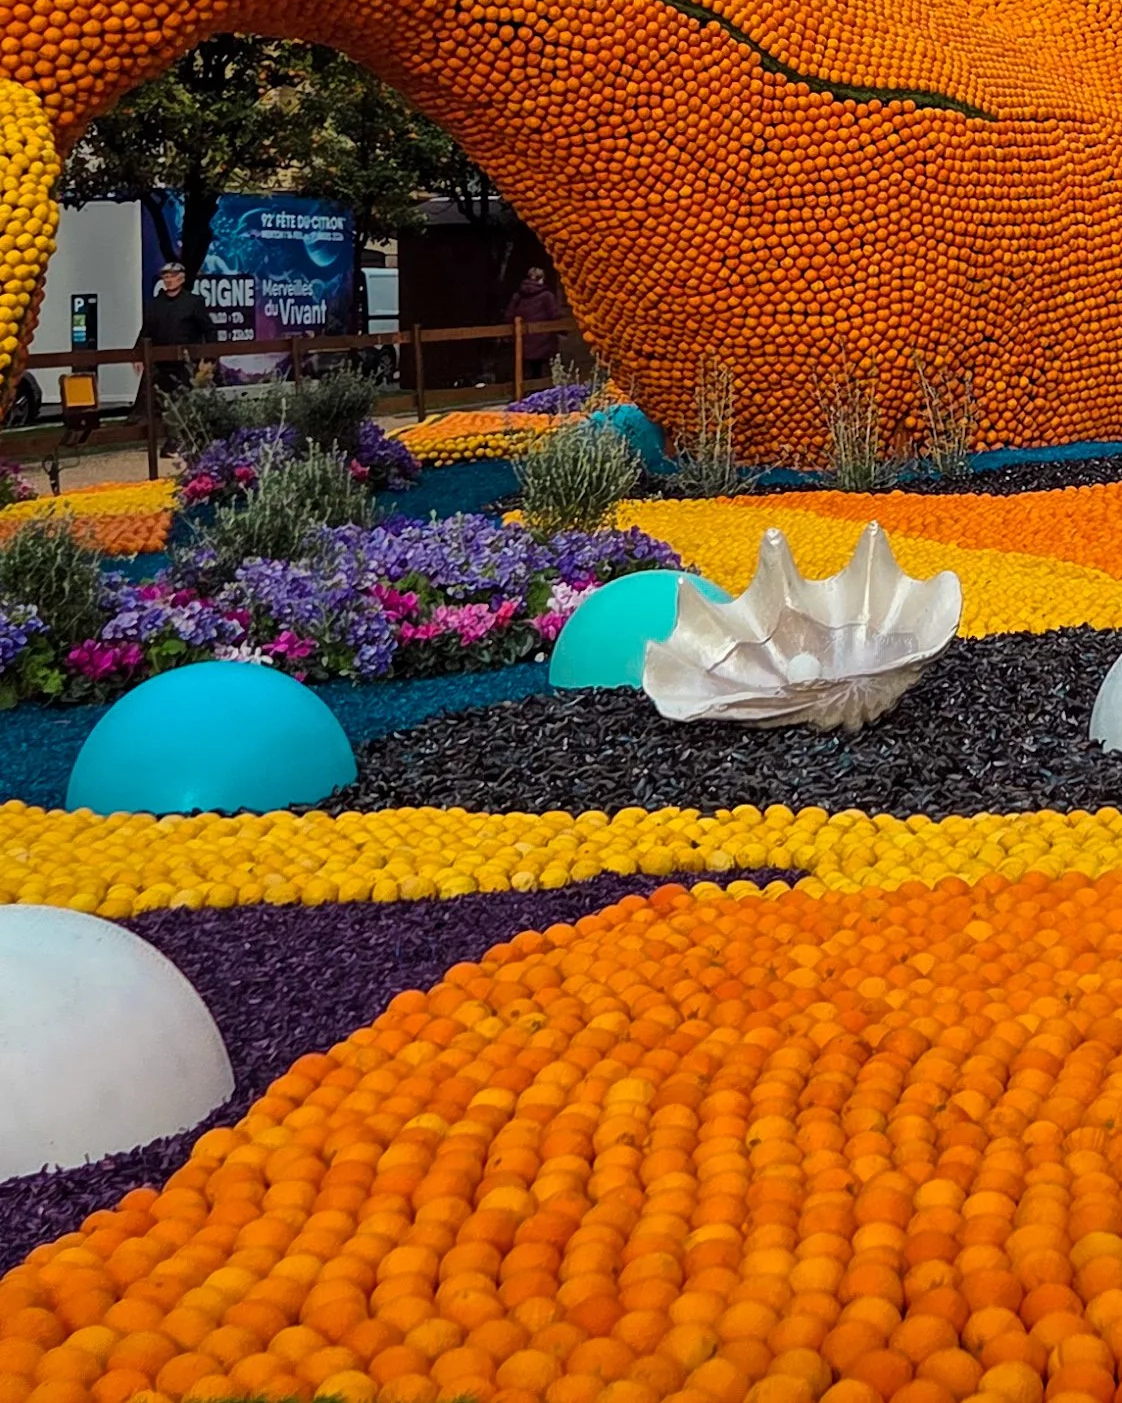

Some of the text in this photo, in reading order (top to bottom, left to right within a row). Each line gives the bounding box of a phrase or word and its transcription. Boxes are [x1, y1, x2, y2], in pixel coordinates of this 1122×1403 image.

[276, 211, 296, 228] FÊTE
[297, 215, 310, 229] DU
[262, 279, 314, 297] Merveilles
[74, 297, 85, 313] P
[264, 298, 327, 325] du Vivant
